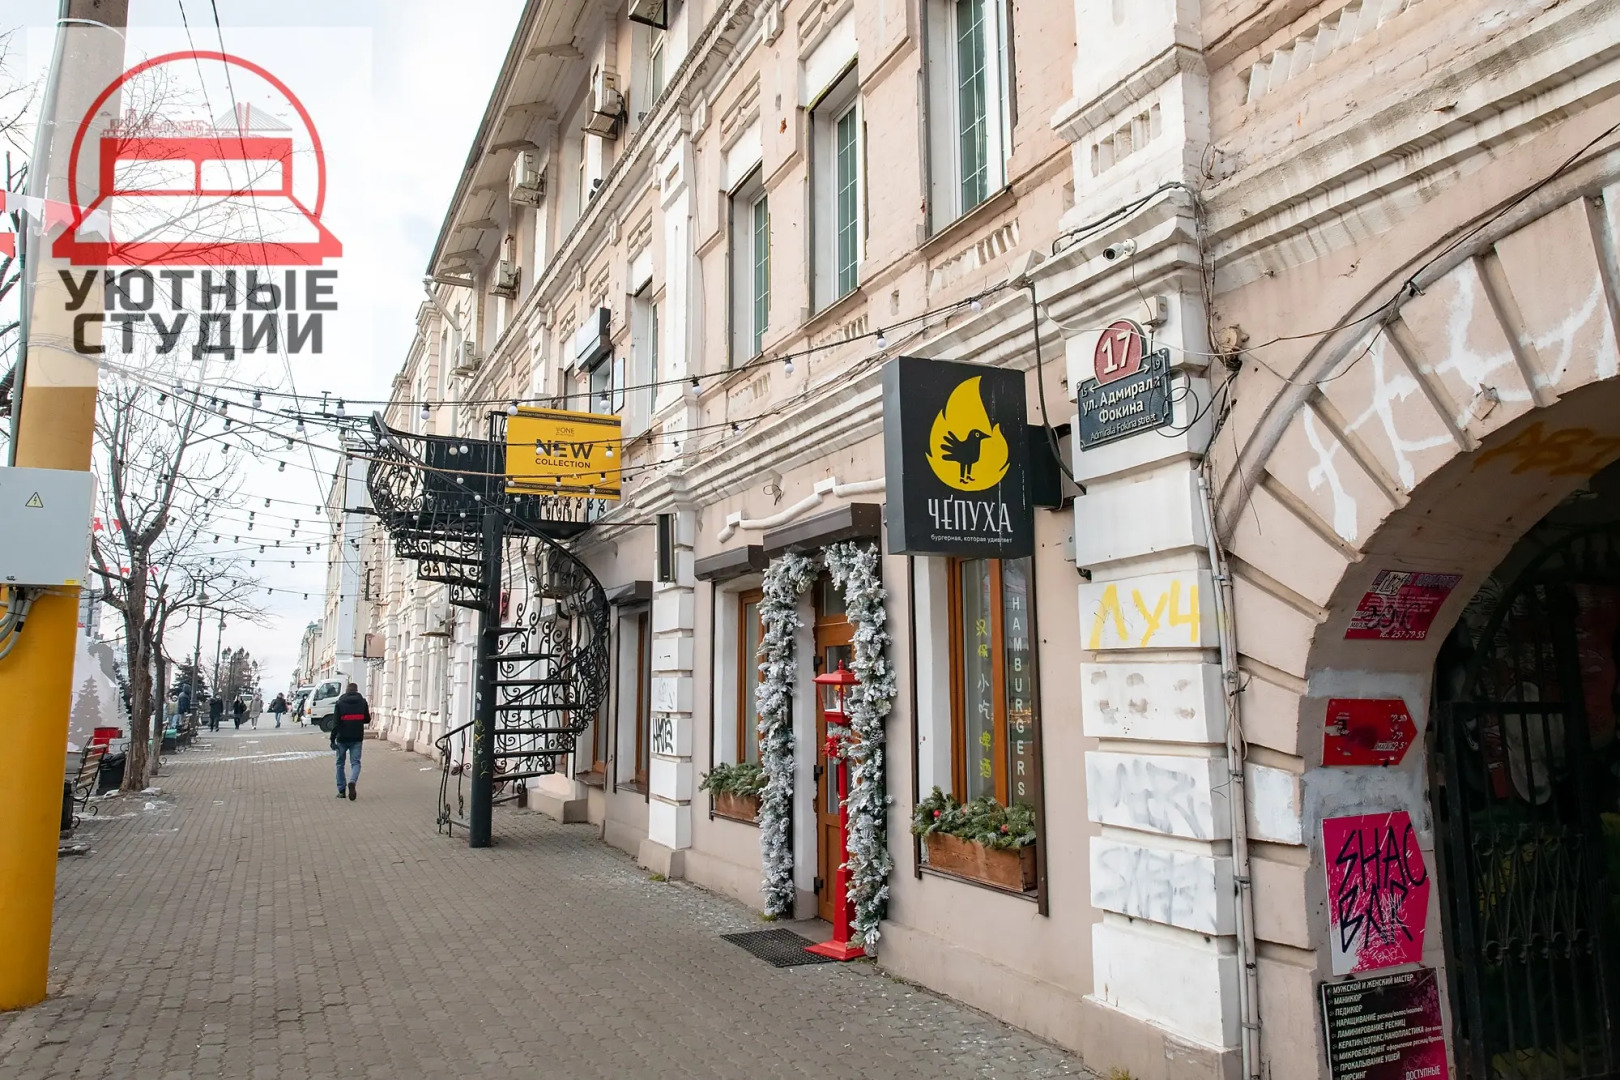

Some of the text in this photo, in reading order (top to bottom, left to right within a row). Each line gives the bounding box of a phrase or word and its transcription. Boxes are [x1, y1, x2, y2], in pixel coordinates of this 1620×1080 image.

[1102, 329, 1133, 374] 17
[1083, 376, 1160, 415] ул. Адмирала
[1099, 400, 1144, 424] Фокина
[1117, 418, 1137, 434] Fokina
[536, 438, 594, 459] NEW
[535, 458, 591, 469] COLLECTION
[930, 533, 963, 542] бургерная,
[1012, 597, 1026, 796] HAMBURGERS
[1332, 974, 1414, 994] МУЖСКОЙ И ЖЕНСКИЙ МАСТЕР
[1333, 994, 1362, 1005] МАНИКЮР
[1335, 1005, 1363, 1016] ПЕДИКЮР
[1336, 1013, 1376, 1027] НАРАЩИВАНИЕ
[1337, 1019, 1406, 1038] ЛАМИНИРОВАНИЕ РЕСНИЦ
[1339, 1044, 1386, 1060] МИКРОБЛЕЙДИНГ
[1340, 1051, 1401, 1071] ПРОКАЛЫВАНИЕ УШЕЙ
[1341, 1070, 1367, 1080] ПИРСИНГ
[1406, 1065, 1441, 1080] ДОСТУПНЫЕ
